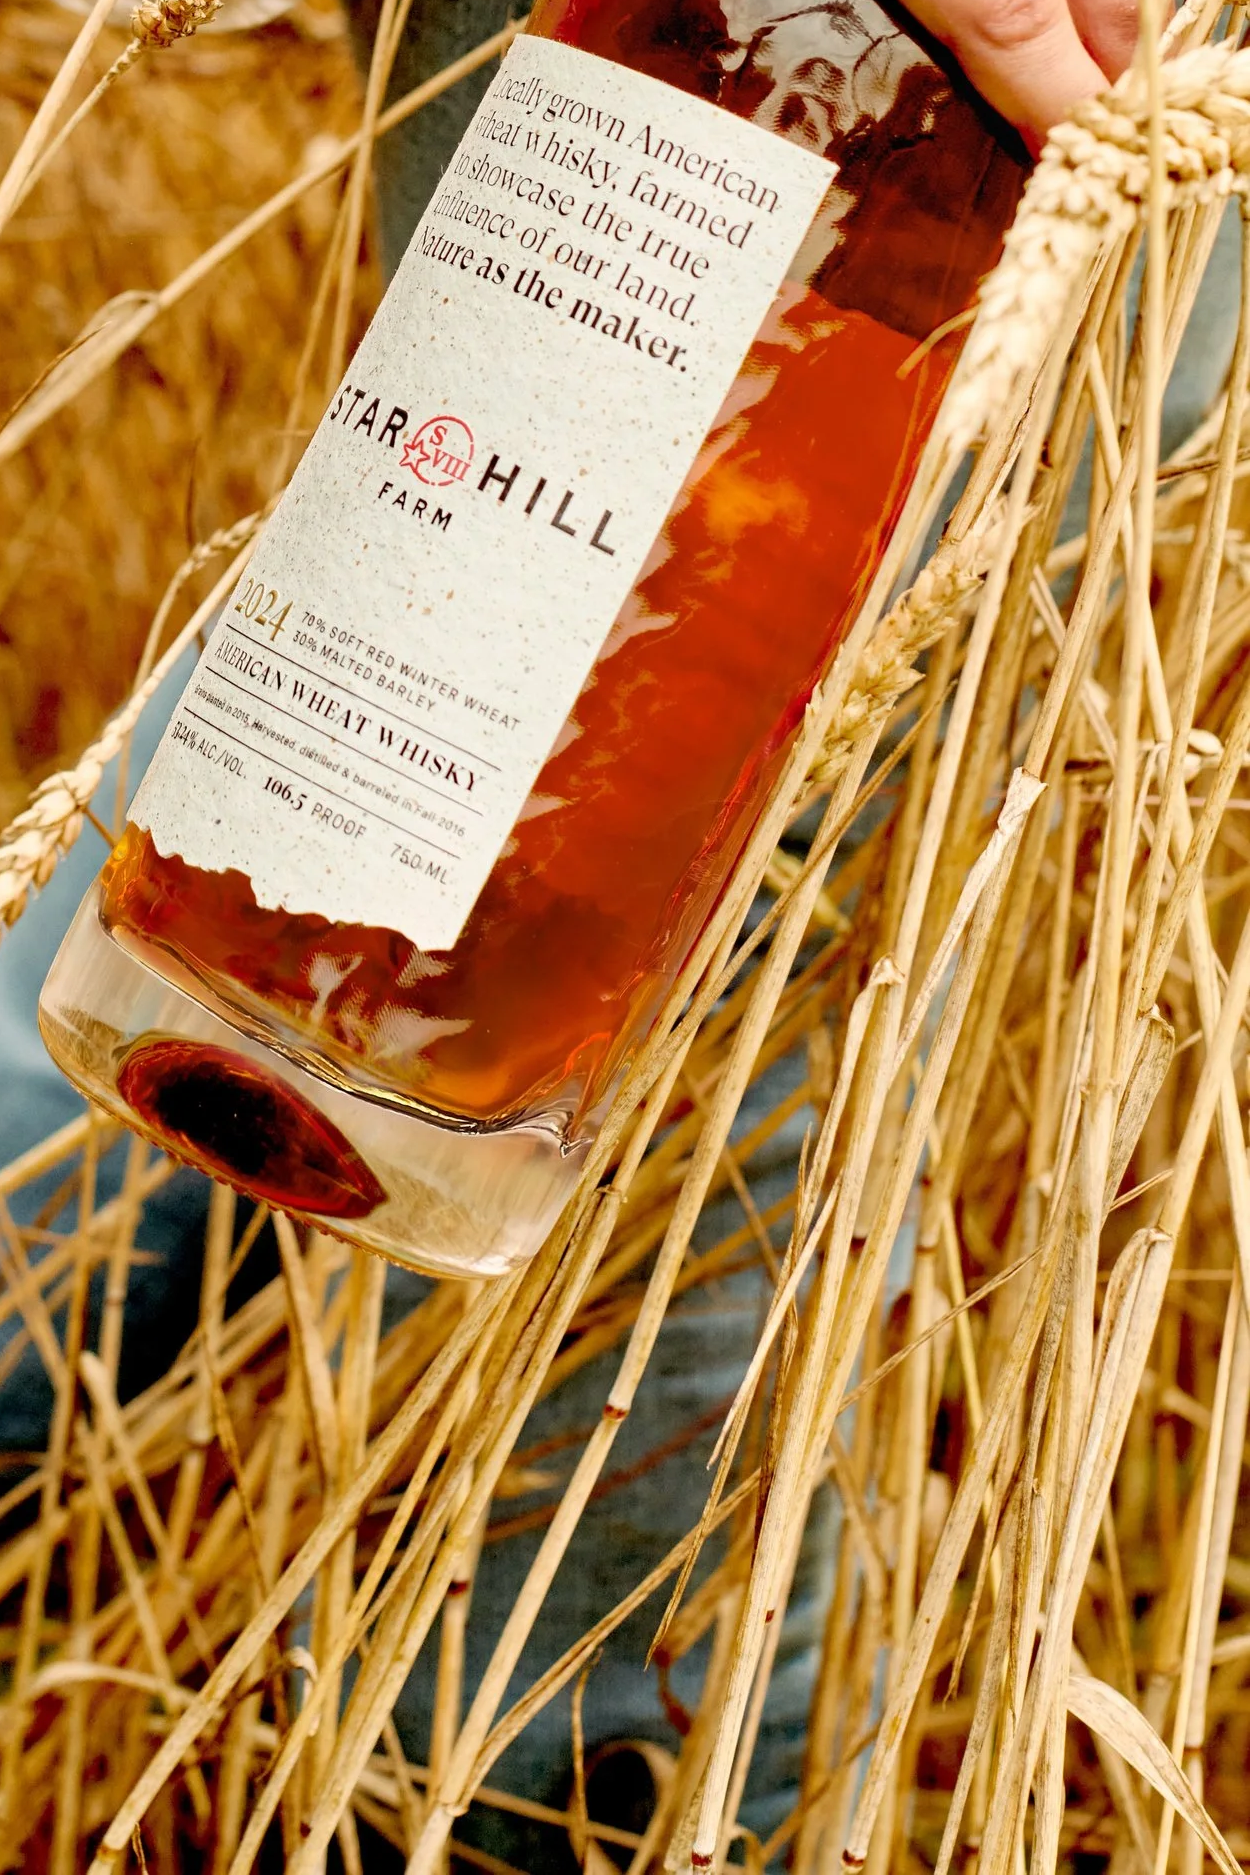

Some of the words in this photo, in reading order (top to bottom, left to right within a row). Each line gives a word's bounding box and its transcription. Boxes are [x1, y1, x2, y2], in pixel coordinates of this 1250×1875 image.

[472, 110, 523, 148] wheat
[525, 130, 621, 192] whisky,
[627, 170, 754, 250] farmed
[491, 69, 551, 116] Locally
[542, 93, 626, 143] grown
[627, 124, 779, 214] American
[431, 185, 516, 241] influence
[519, 226, 557, 255] of
[553, 243, 611, 281] our
[614, 262, 696, 327] land.
[453, 153, 471, 176] to
[467, 153, 576, 217] showcase
[581, 202, 633, 243] the
[636, 229, 710, 279] true
[413, 224, 475, 271] Nature
[475, 256, 510, 285] as
[512, 268, 563, 310] the
[568, 298, 687, 373] maker.
[330, 384, 409, 449] STAR
[476, 453, 616, 557] HILL
[428, 424, 448, 447] S
[431, 447, 472, 482] VIII
[377, 480, 453, 533] FARM
[234, 578, 294, 642] 2024
[292, 629, 318, 653] 30%
[319, 644, 373, 681] MALTED
[375, 673, 436, 712] BARLEY
[301, 610, 326, 634] 70%
[328, 626, 365, 651] SOFT
[365, 644, 395, 670] RED
[399, 662, 459, 702] WINTER
[463, 694, 521, 731] WHEAT
[196, 738, 247, 780] ALC./VOL.
[205, 692, 227, 711] planted
[224, 702, 233, 715] in
[298, 745, 341, 773] distilled
[341, 767, 350, 779] &
[352, 772, 401, 805] barreled
[401, 798, 413, 812] in
[413, 802, 437, 822] Fall
[437, 816, 466, 838] 2016
[213, 640, 288, 691] AMERICAN
[292, 679, 371, 735] WHEAT
[379, 725, 486, 792] WHISKY
[263, 776, 308, 811] 106.5
[310, 801, 367, 839] PROOF
[390, 842, 422, 870] 750
[424, 860, 447, 885] ML
